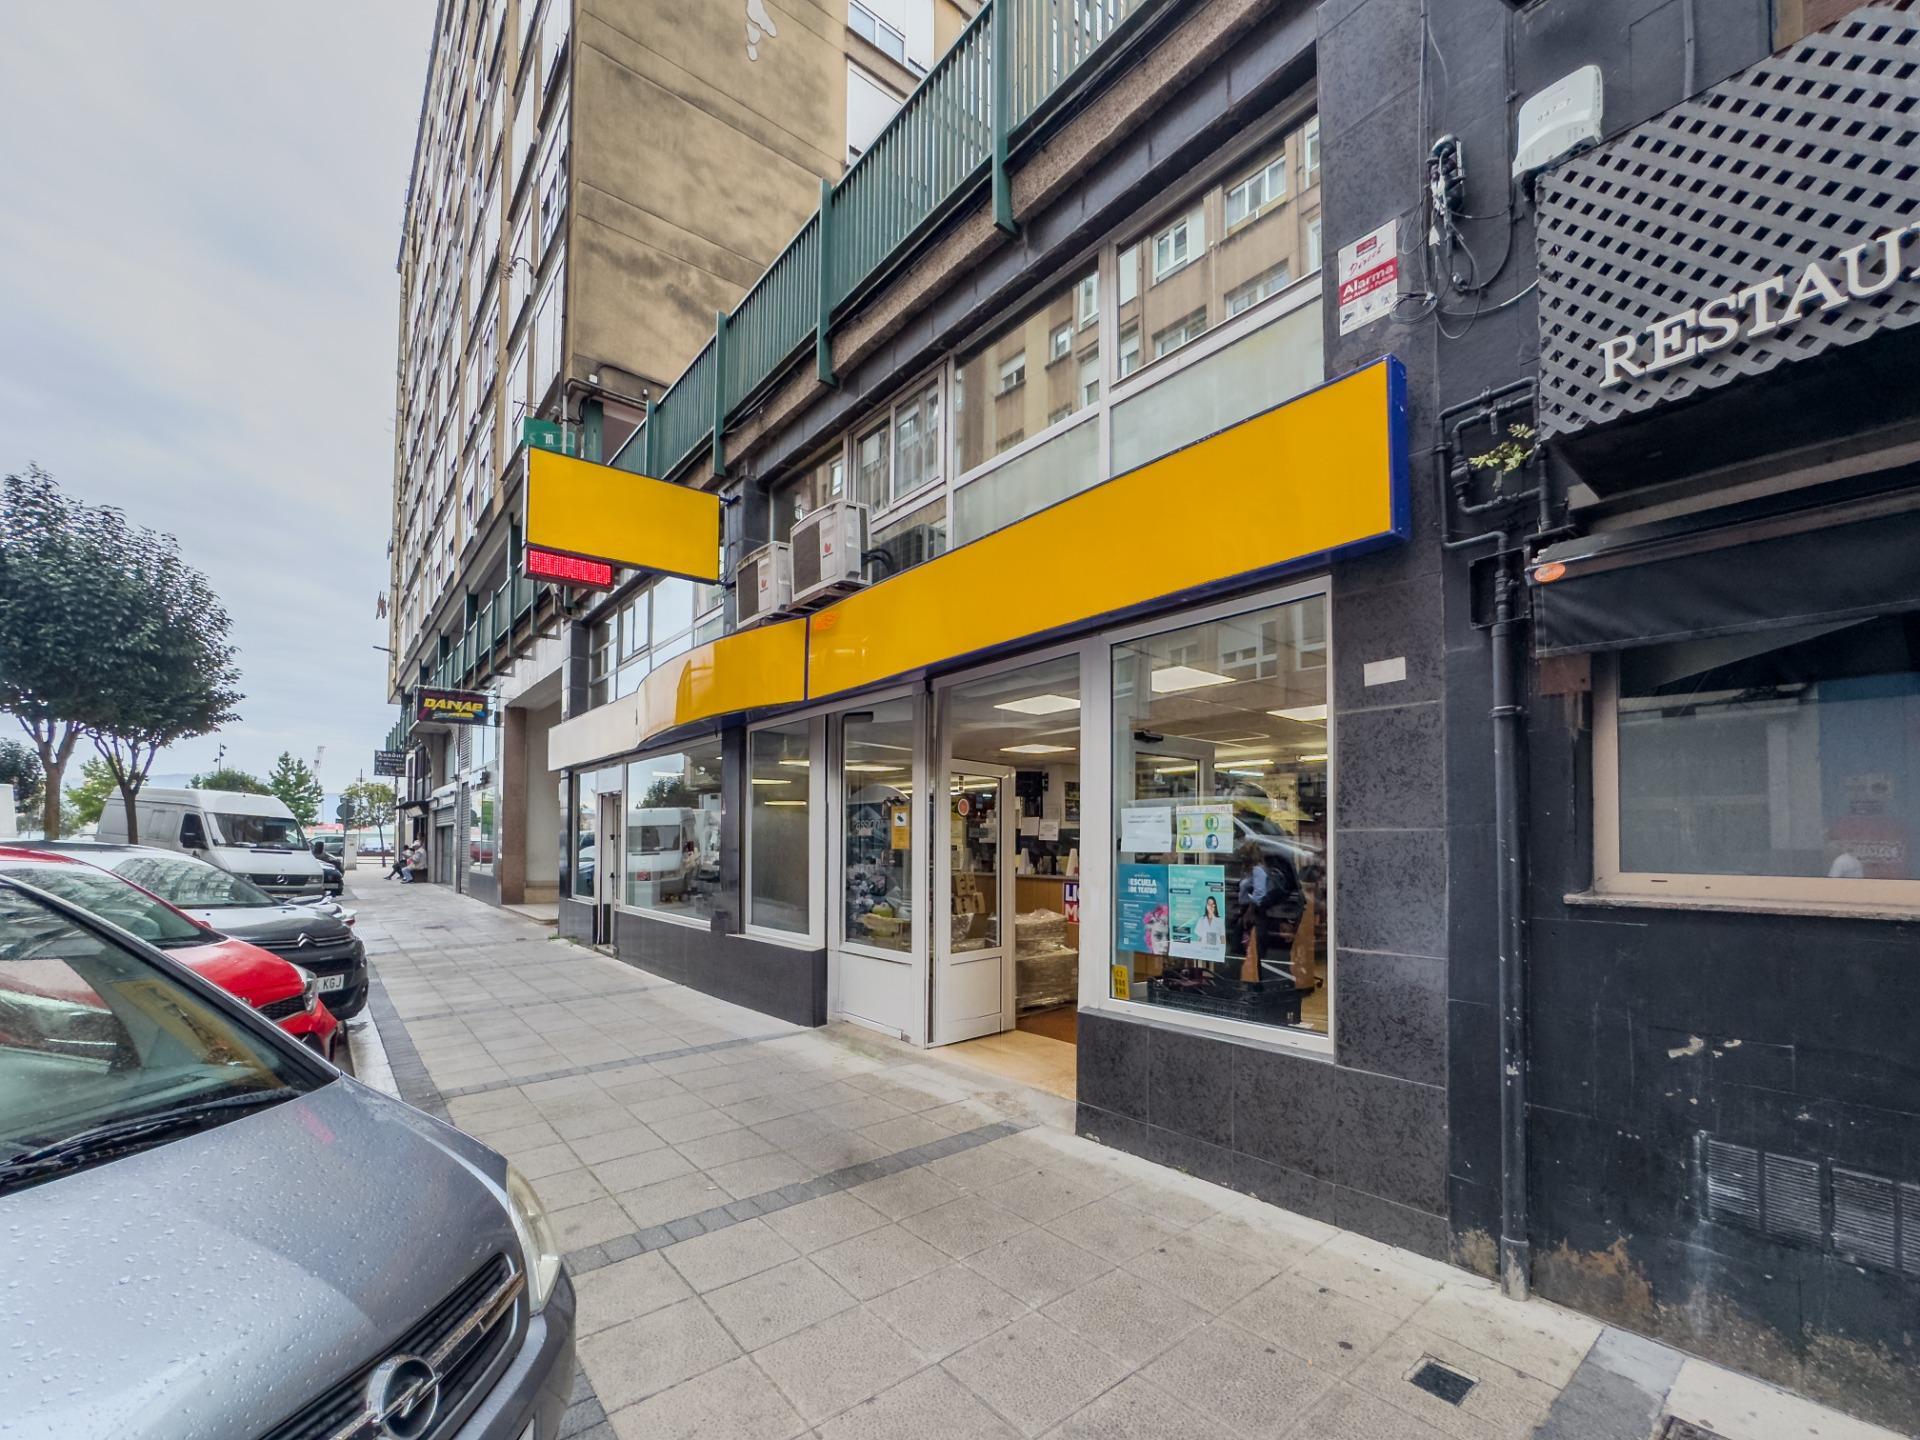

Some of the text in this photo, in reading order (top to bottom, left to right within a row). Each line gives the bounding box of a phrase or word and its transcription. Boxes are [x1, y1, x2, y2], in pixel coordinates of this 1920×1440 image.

[1343, 264, 1394, 297] Alarma
[1599, 222, 1920, 388] RESTAU
[1129, 878, 1157, 888] ESCUELA
[1065, 884, 1079, 901] LI
[1065, 902, 1079, 921] M
[323, 976, 342, 990] KGJ
